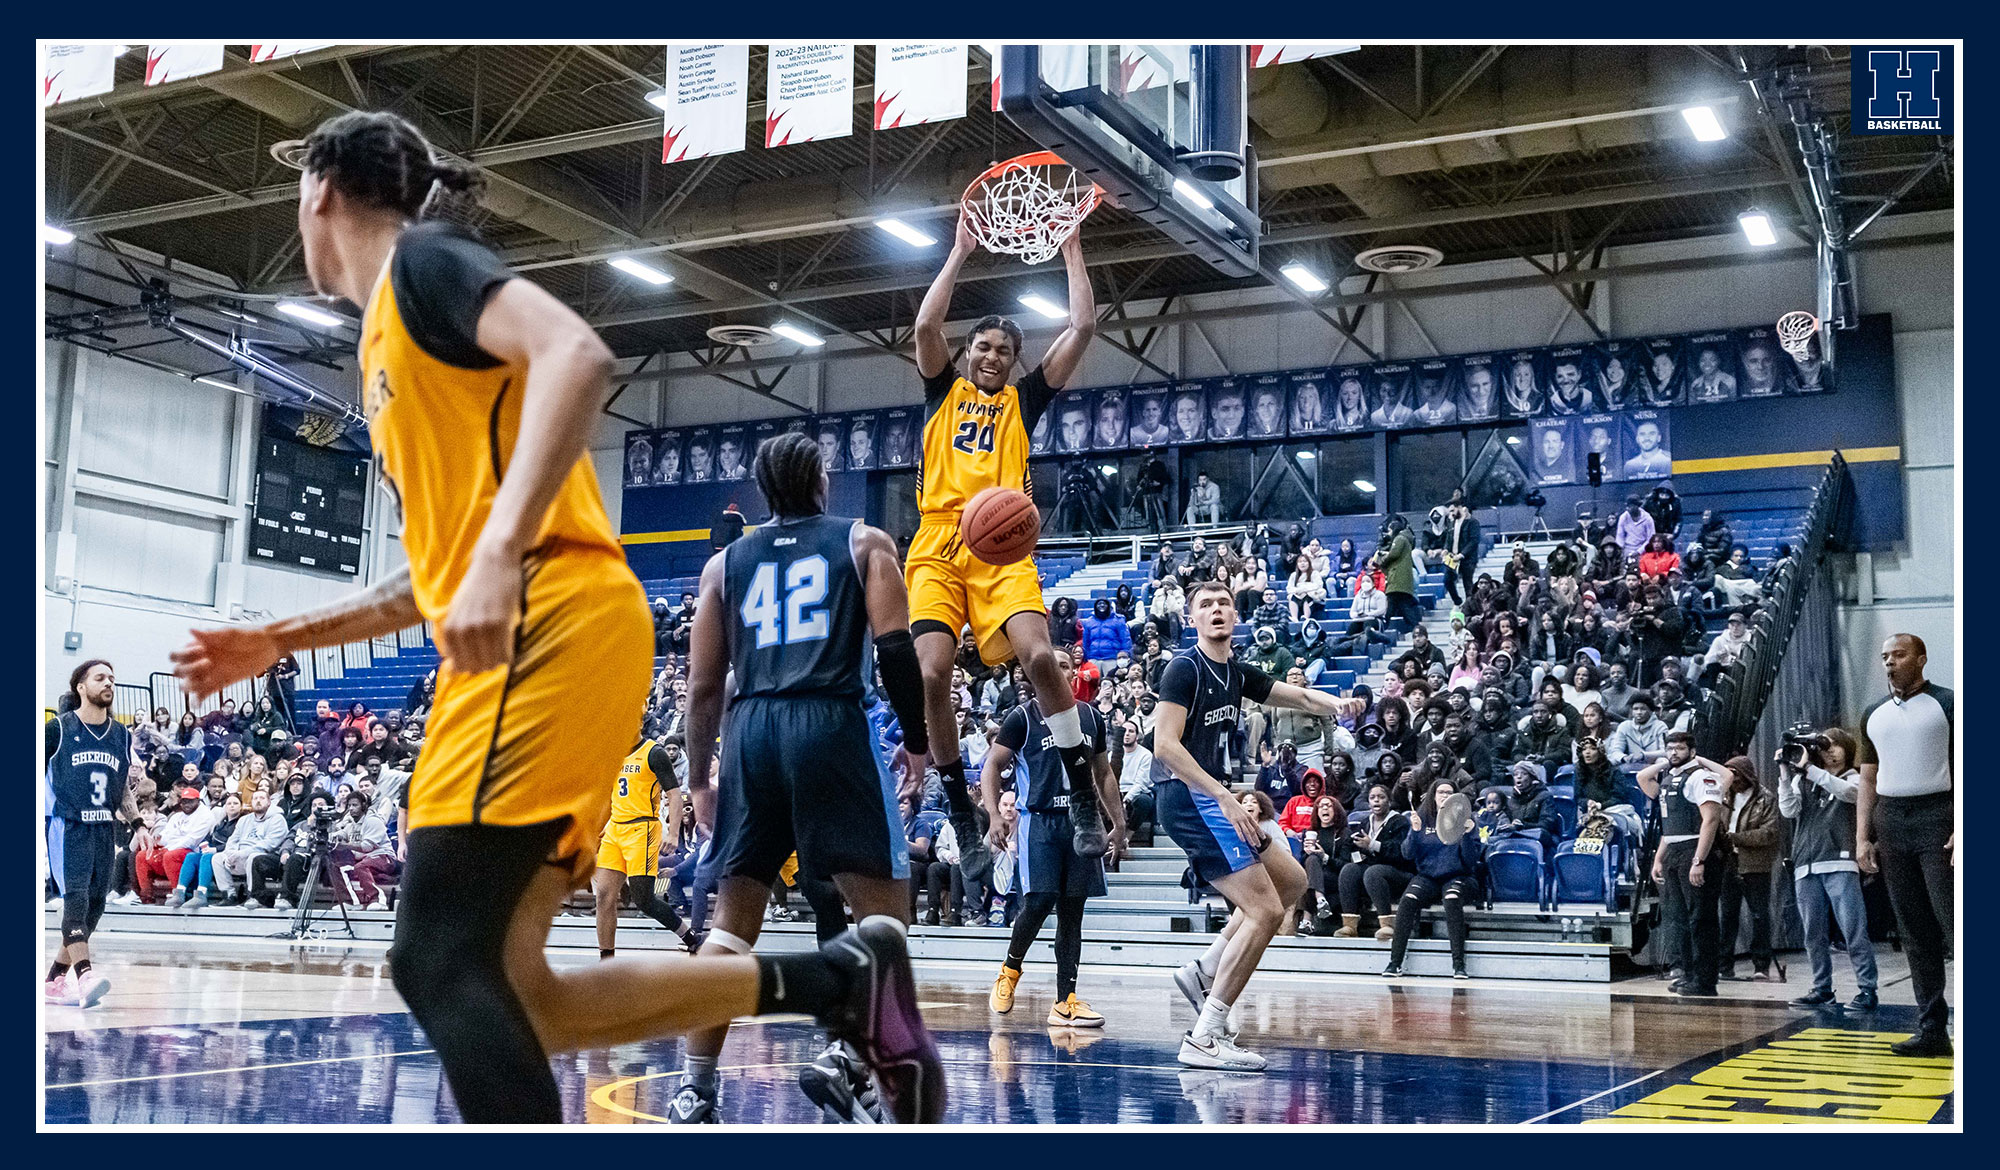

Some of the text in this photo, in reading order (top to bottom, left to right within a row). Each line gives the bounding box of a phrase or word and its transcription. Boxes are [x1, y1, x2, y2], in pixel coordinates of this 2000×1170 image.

[775, 44, 846, 57] 2022-23 NATIO
[807, 50, 832, 59] DOUBLES
[777, 54, 844, 70] BADMINTON CHAMPIONS
[1429, 410, 1442, 419] 23
[1347, 417, 1353, 426] 8
[1535, 420, 1567, 428] CHATEAU
[1583, 415, 1613, 424] DICKSON
[1264, 425, 1271, 434] 3
[1304, 421, 1314, 430] 11
[1184, 431, 1192, 440] 5
[1224, 427, 1231, 437] 3
[1109, 437, 1116, 446] 9
[1146, 434, 1153, 443] 2
[1032, 443, 1044, 452] 29
[858, 459, 865, 467] 3
[891, 455, 902, 464] 43
[1643, 462, 1652, 472] 7
[634, 476, 643, 484] 10
[664, 474, 673, 482] 12
[695, 471, 705, 480] 19
[992, 511, 1038, 546] Wilson
[740, 553, 830, 650] 42
[71, 751, 120, 773] SHERIDAN
[89, 771, 108, 807] 3
[617, 777, 628, 797] 3
